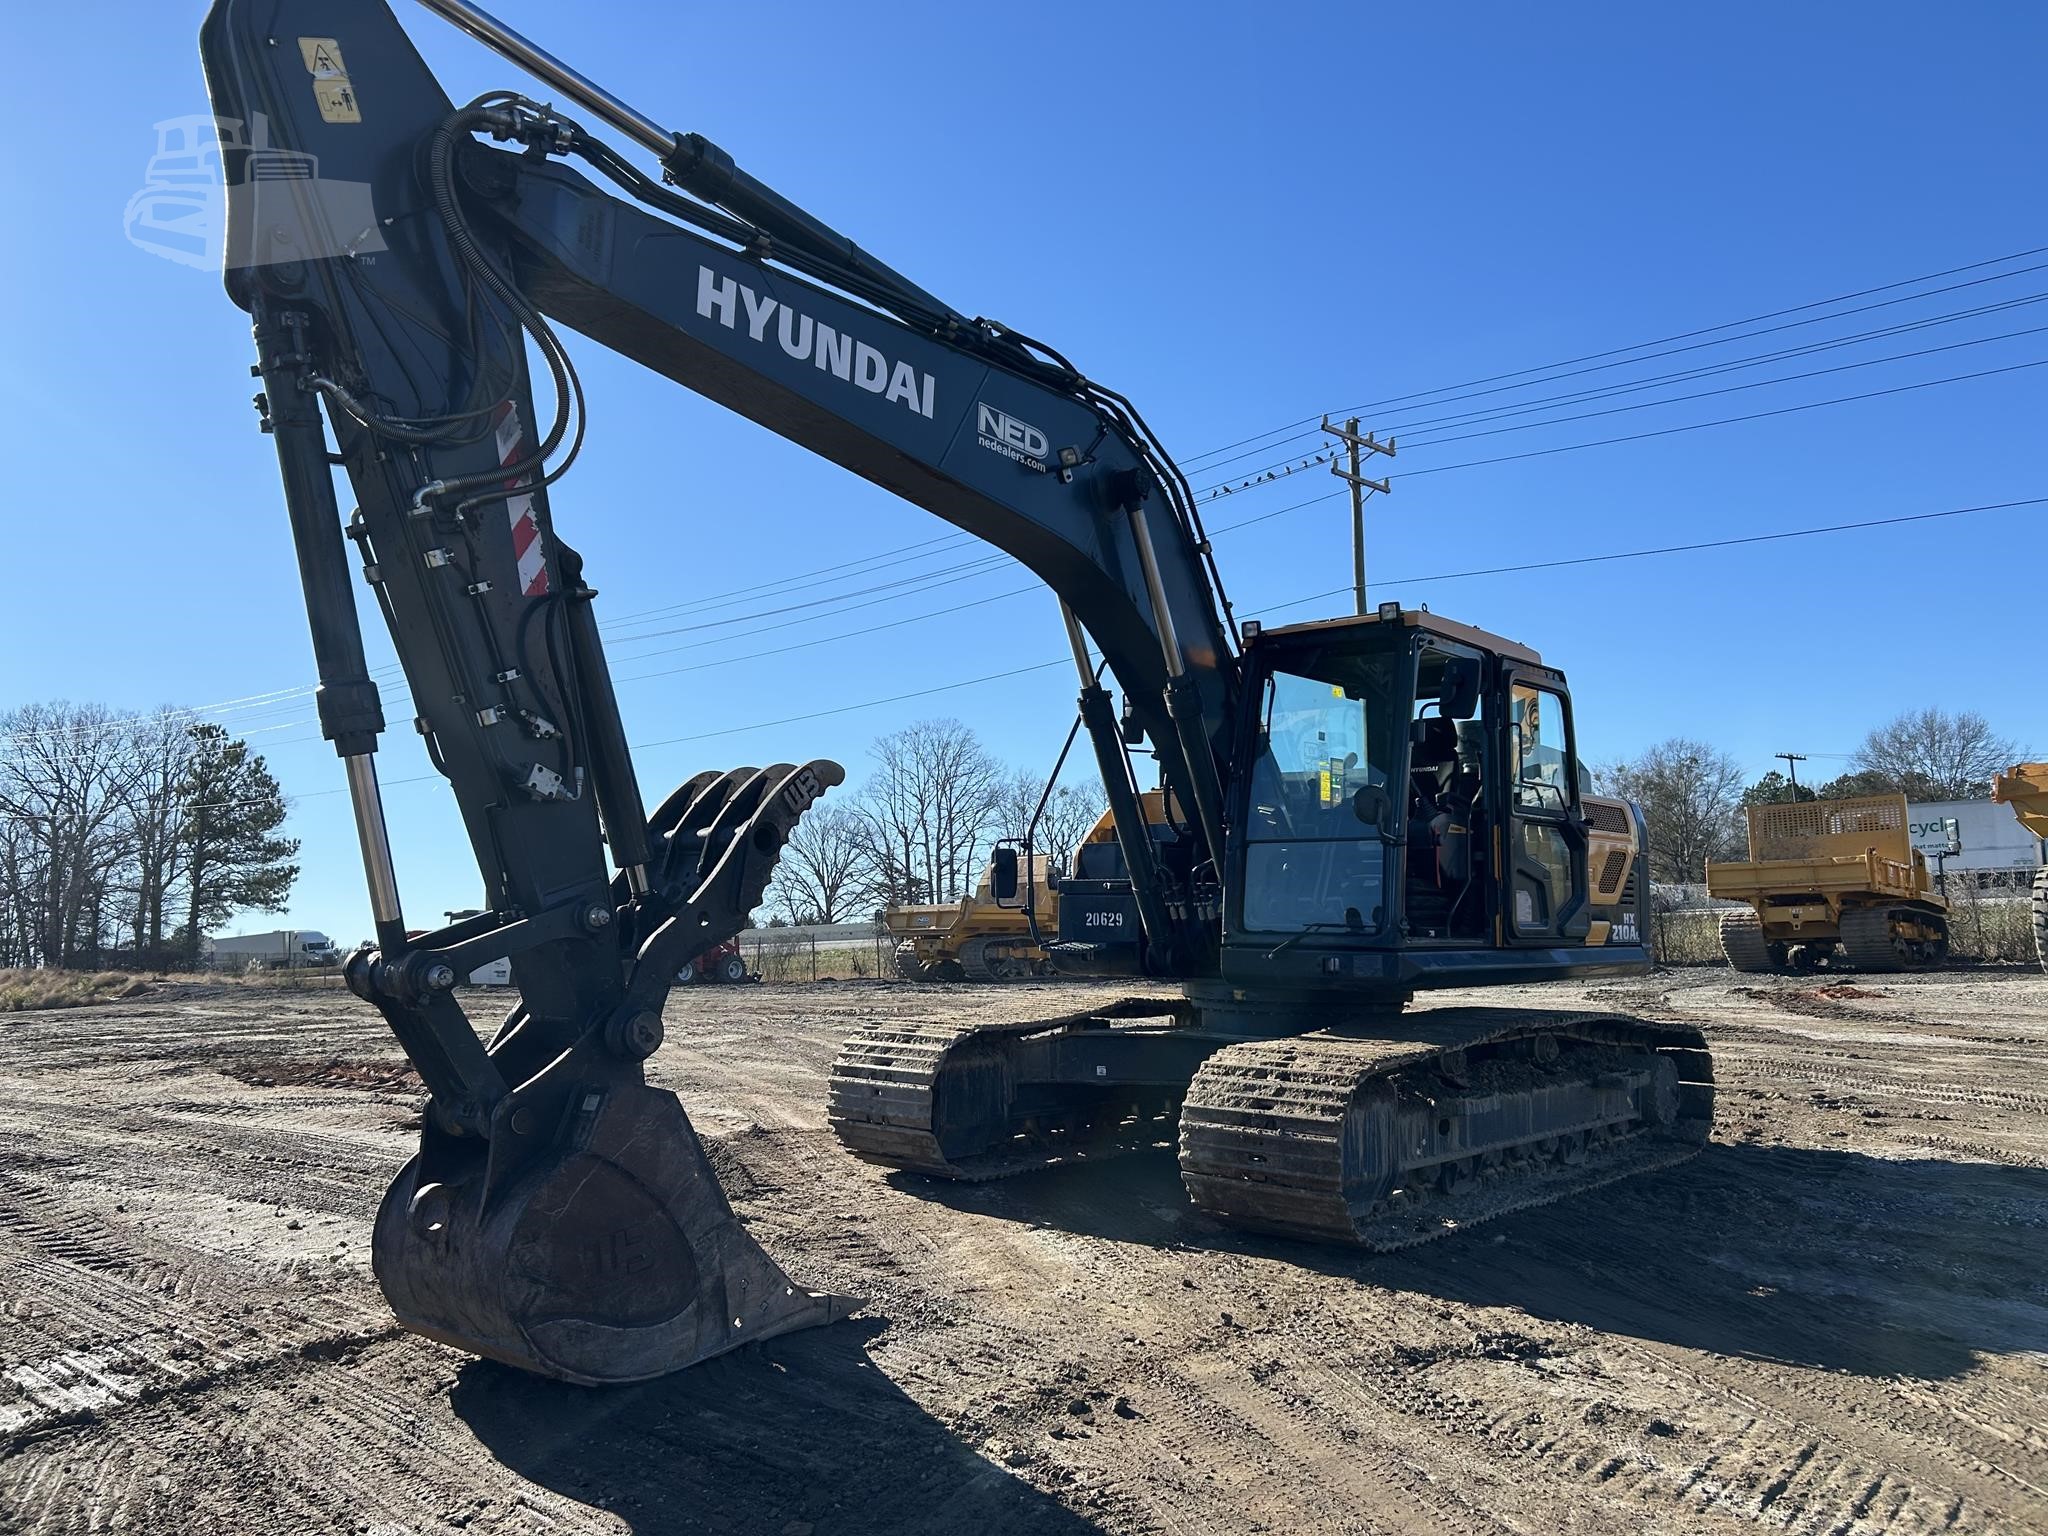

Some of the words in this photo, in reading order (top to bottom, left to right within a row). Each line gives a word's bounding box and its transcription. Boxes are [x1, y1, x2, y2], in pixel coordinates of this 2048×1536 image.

[696, 264, 936, 420] HYUNDAI
[979, 405, 1048, 457] NED
[978, 436, 1046, 473] nedealers.com
[1410, 765, 1439, 773] HYUNDAI
[1909, 817, 1949, 837] cycl
[1085, 912, 1123, 926] 20629
[1623, 912, 1635, 925] HX
